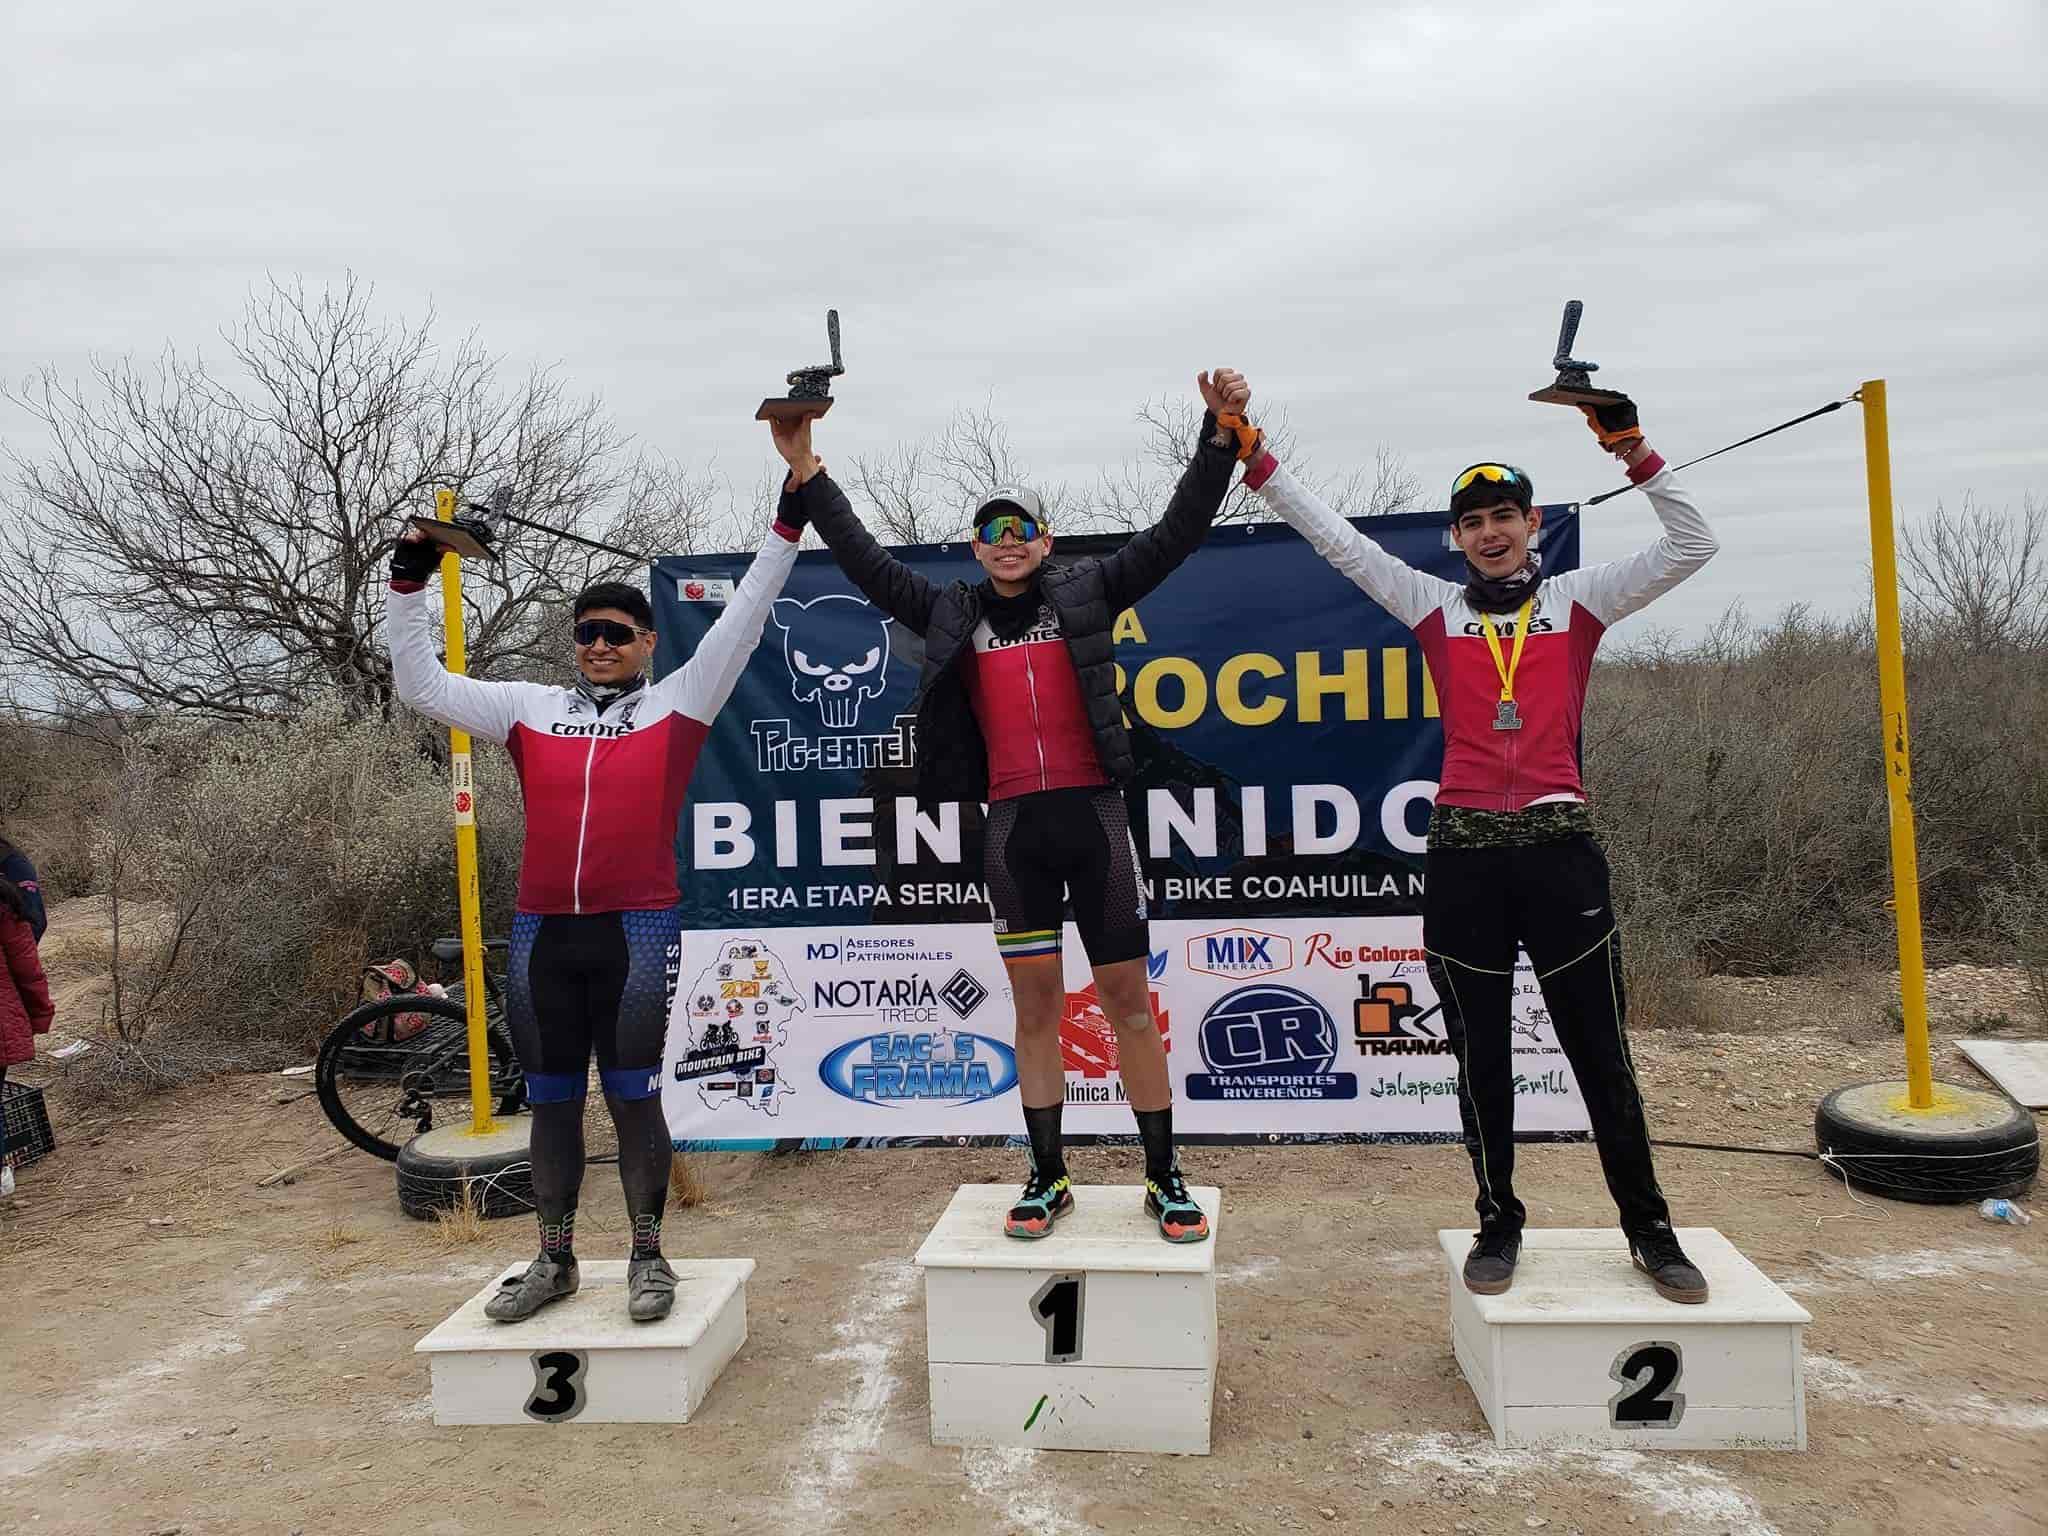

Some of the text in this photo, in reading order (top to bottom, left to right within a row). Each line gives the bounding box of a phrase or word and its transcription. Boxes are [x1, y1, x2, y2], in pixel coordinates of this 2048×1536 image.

[1463, 617, 1553, 636] COYOES
[728, 887, 799, 910] 1ERA
[806, 884, 892, 908] ETAPA
[1165, 877, 1233, 900] BIKE
[1242, 874, 1400, 899] COAHUILA
[808, 943, 839, 960] MD
[1206, 937, 1272, 963] MIX
[815, 973, 938, 1009] NOTARÍA
[879, 1007, 939, 1023] TRECE
[676, 1047, 762, 1075] MOUNTAIN BIKE
[852, 1062, 993, 1100] FRAMA
[1207, 1075, 1337, 1086] TRANSPORTES
[1223, 1085, 1323, 1098] RIVEREÑOS
[1038, 1280, 1079, 1355] 1
[529, 1351, 580, 1416] 3
[1616, 1346, 1680, 1422] 2
